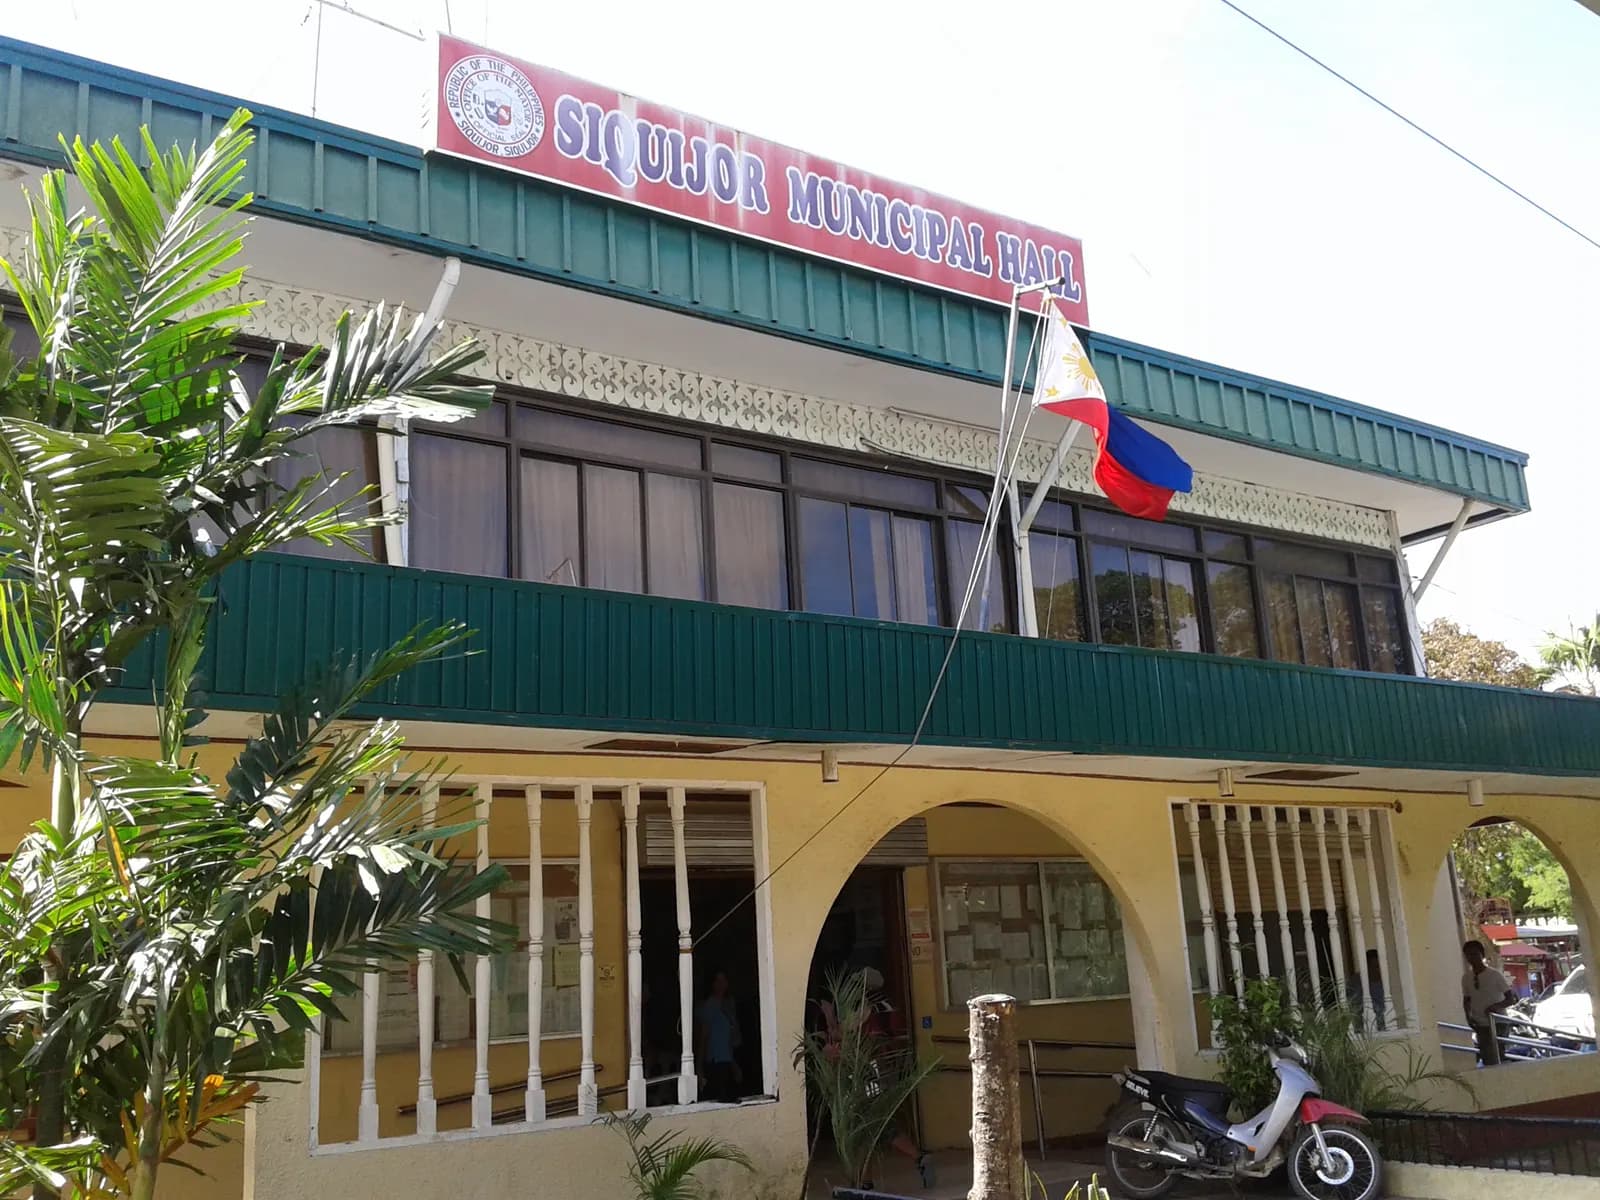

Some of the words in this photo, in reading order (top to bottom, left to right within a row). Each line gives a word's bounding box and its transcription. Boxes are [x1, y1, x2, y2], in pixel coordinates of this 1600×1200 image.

[448, 66, 469, 108] REPUBLIC
[470, 59, 481, 70] OF
[487, 60, 506, 73] THE
[511, 71, 543, 127] PHILIPPINES
[463, 78, 477, 111] OFFICE
[515, 89, 532, 122] MAYOR
[504, 133, 539, 156] SIQUIJOR
[555, 94, 769, 214] SIQUIJOR
[786, 166, 992, 277] MUNICIPAL
[996, 231, 1081, 303] HALL
